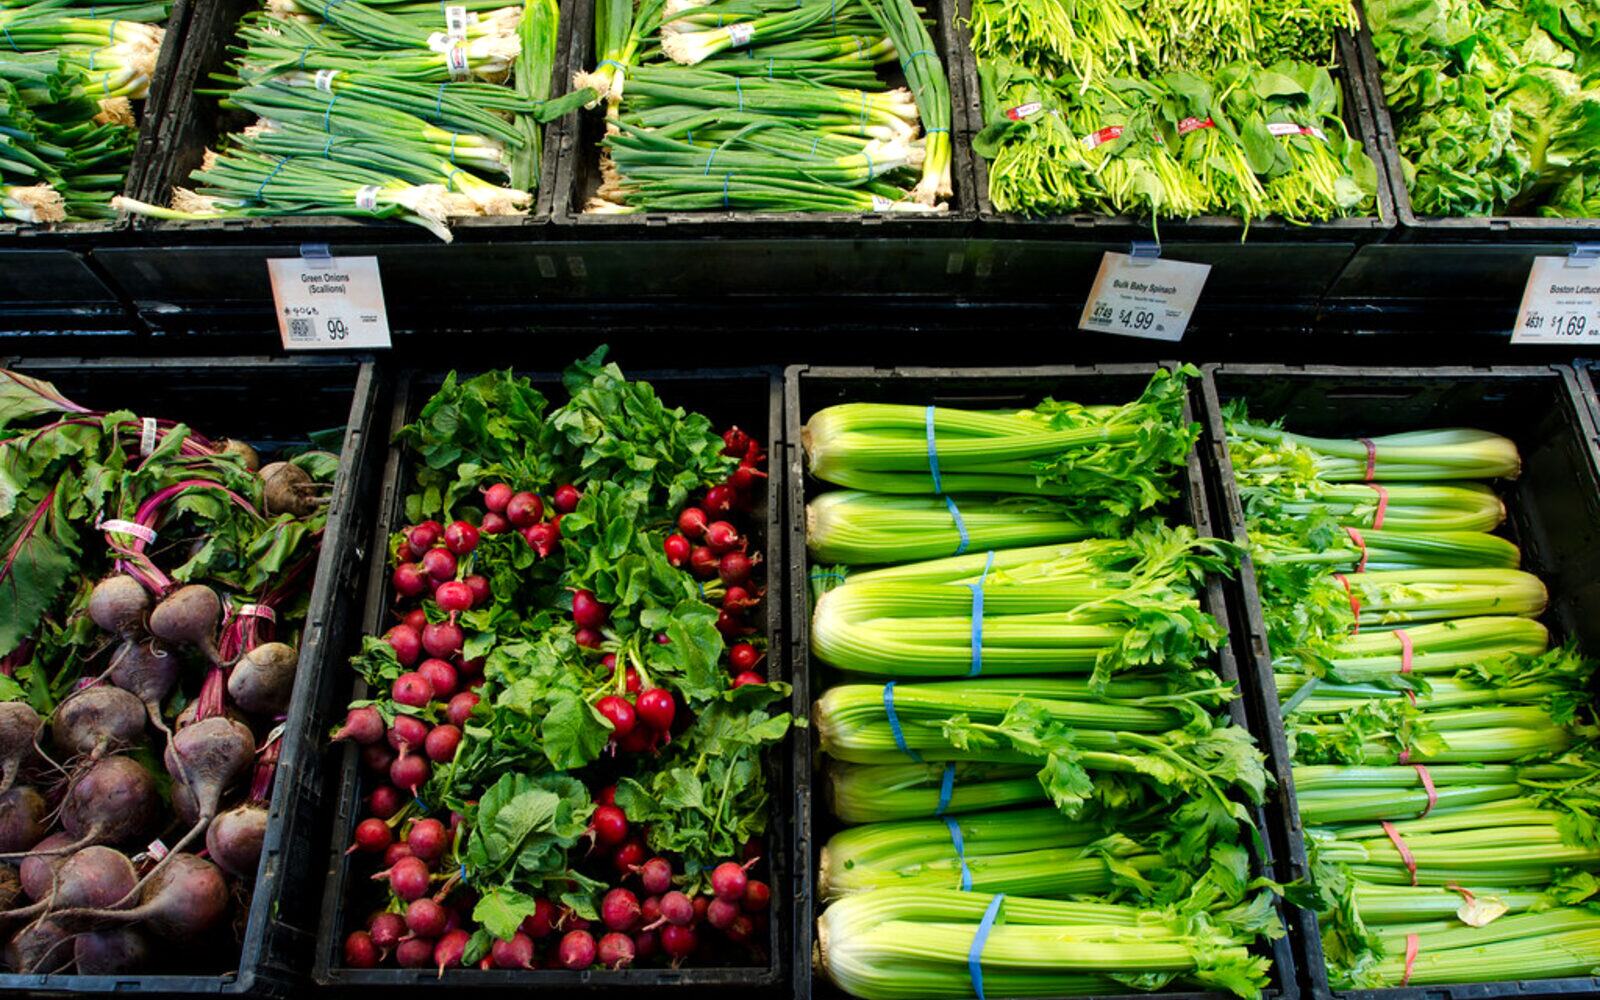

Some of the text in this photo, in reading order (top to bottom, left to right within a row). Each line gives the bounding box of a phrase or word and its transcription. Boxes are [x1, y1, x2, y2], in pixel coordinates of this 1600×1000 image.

[301, 273, 350, 283] Green Onions
[308, 284, 346, 294] (Scallions)
[1112, 279, 1177, 295] Bulk Baby Spinach
[1549, 284, 1575, 294] Boston
[1119, 309, 1154, 330] $4.99
[1551, 315, 1587, 336] $1.69
